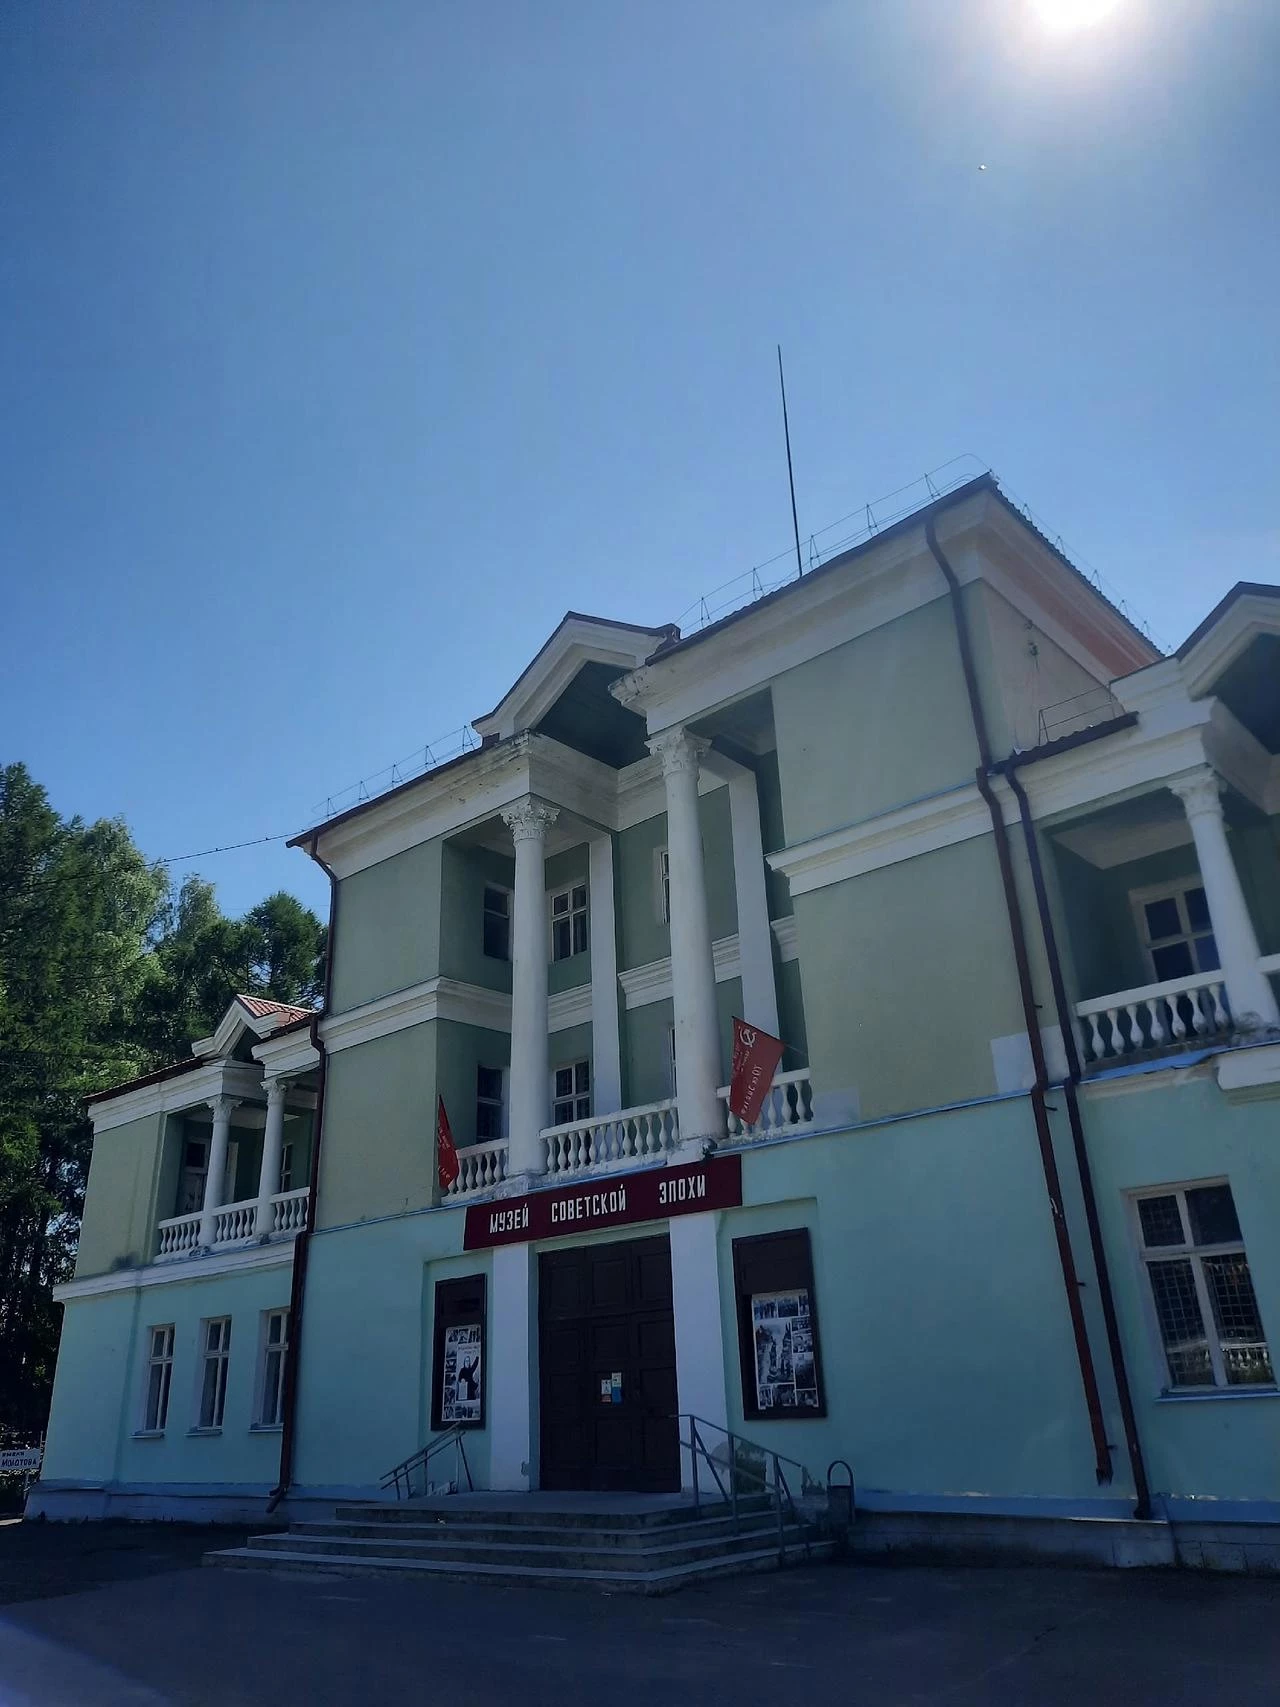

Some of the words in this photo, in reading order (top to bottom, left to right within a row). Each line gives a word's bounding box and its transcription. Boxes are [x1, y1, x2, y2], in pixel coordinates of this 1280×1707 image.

[490, 1204, 529, 1233] МУЗЕЙ
[551, 1184, 626, 1223] СОВЕТСКОЙ
[659, 1175, 706, 1204] ЭПОХИ
